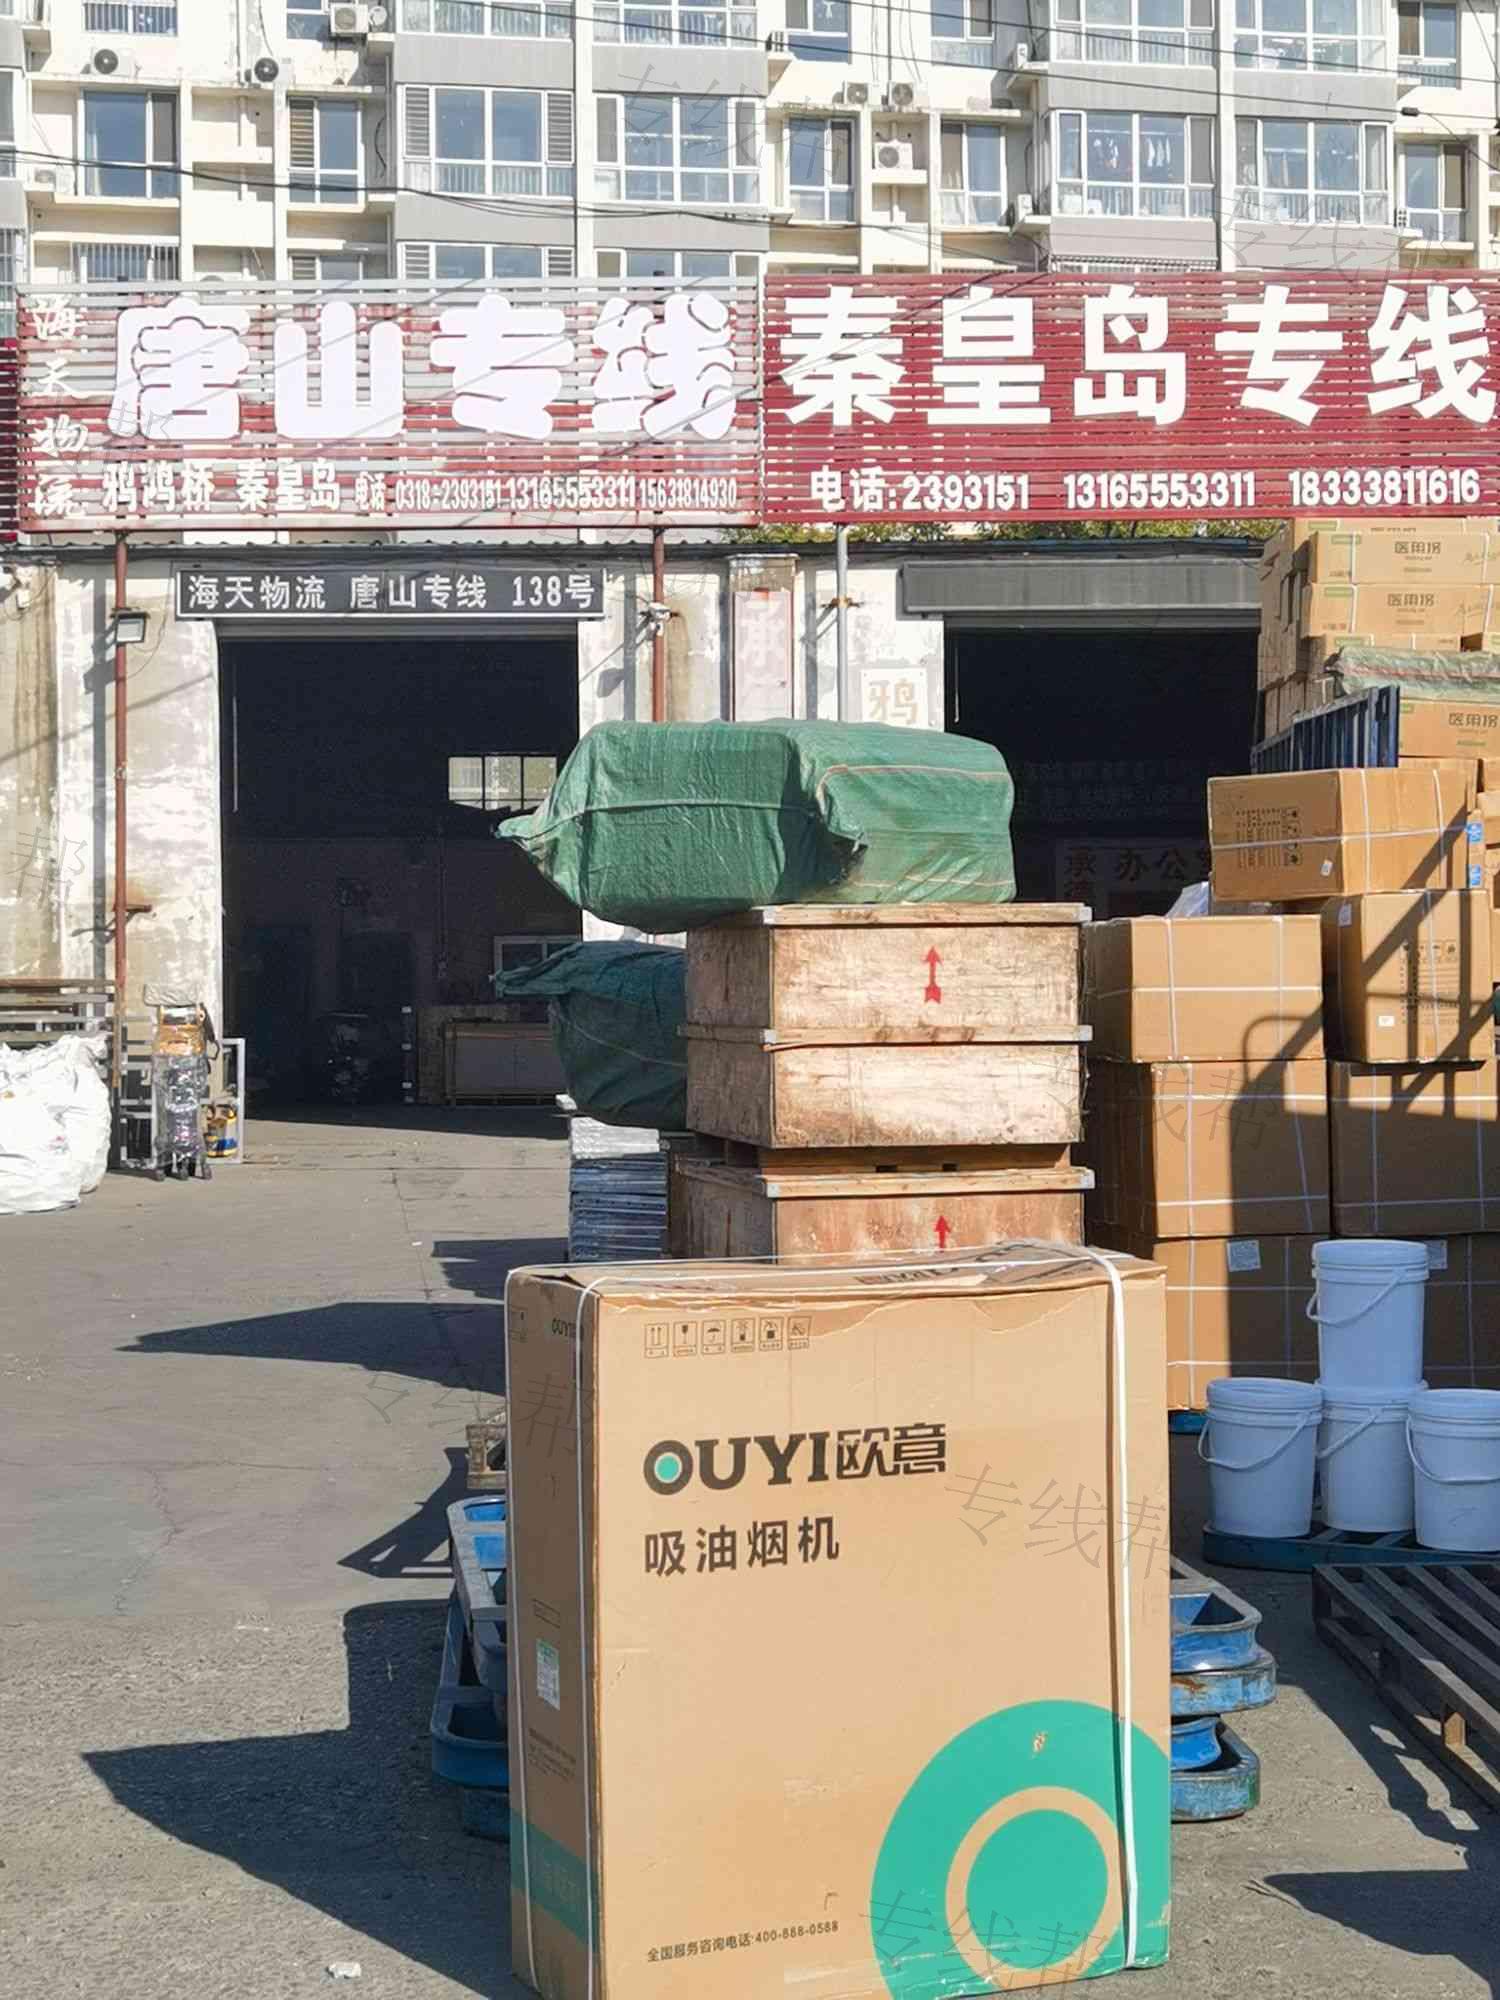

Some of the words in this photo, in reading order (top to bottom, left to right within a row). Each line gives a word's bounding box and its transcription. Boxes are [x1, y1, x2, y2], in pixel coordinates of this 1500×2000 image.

[108, 293, 736, 441] 唐山专线
[779, 284, 1500, 427] 秦皇岛专线
[102, 459, 215, 512] 鸦鸿桥
[236, 457, 341, 511] 秦皇岛
[355, 470, 386, 511] 电话
[505, 473, 637, 510] 13165553311
[809, 463, 1030, 513] 电话:2393151
[1063, 471, 1256, 509] 13165553311
[1289, 467, 1481, 505] 18333811616
[188, 574, 327, 611] 海天物流
[350, 573, 488, 611] 唐山专线
[511, 574, 596, 610] 138号
[644, 1515, 840, 1577] 吸油烟机
